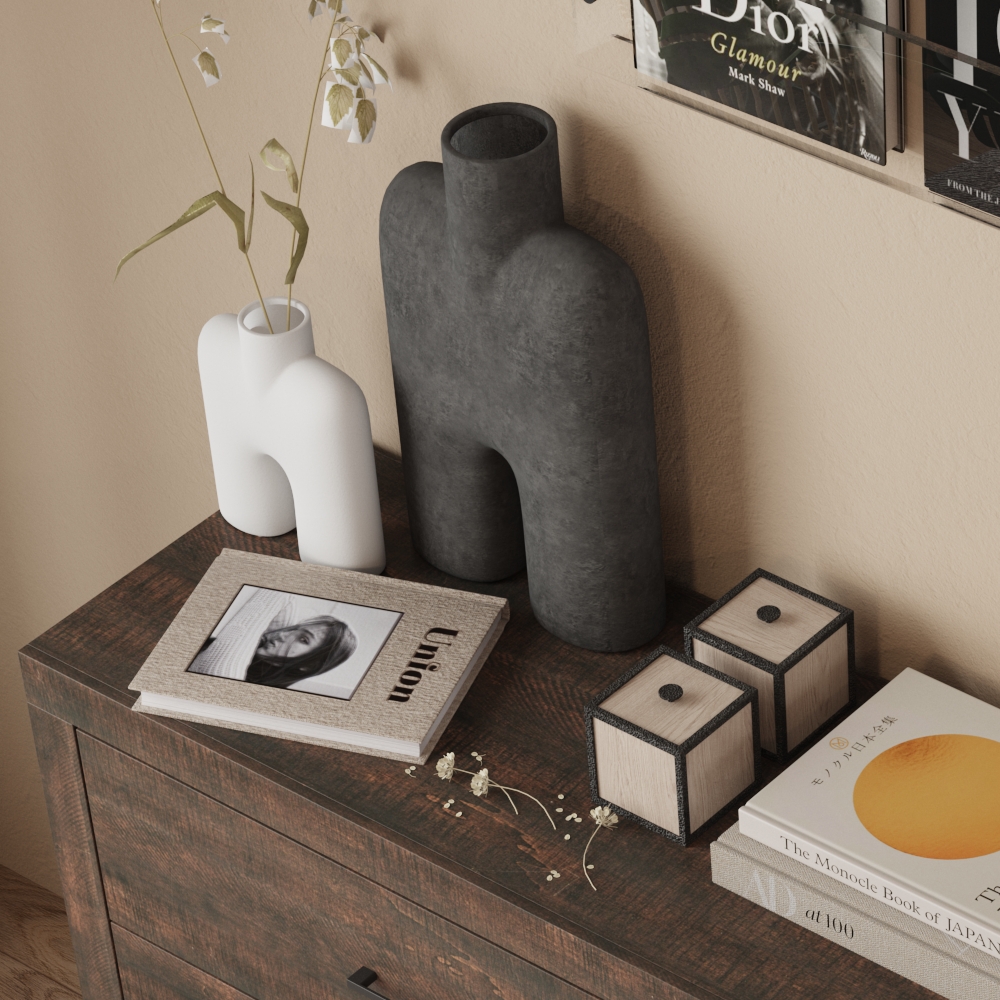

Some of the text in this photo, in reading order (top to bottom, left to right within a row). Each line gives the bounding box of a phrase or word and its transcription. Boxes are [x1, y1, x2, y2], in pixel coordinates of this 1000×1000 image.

[710, 31, 802, 82] Glamour
[728, 65, 786, 97] Mark Shaw
[947, 178, 973, 196] FROM
[973, 188, 993, 204] THE
[387, 627, 460, 702] Union
[811, 715, 899, 786] モノクル日本全集
[780, 834, 810, 860] The
[815, 852, 878, 894] Monocle
[882, 885, 921, 916] Book
[925, 912, 941, 925] of
[805, 909, 855, 940] at 100
